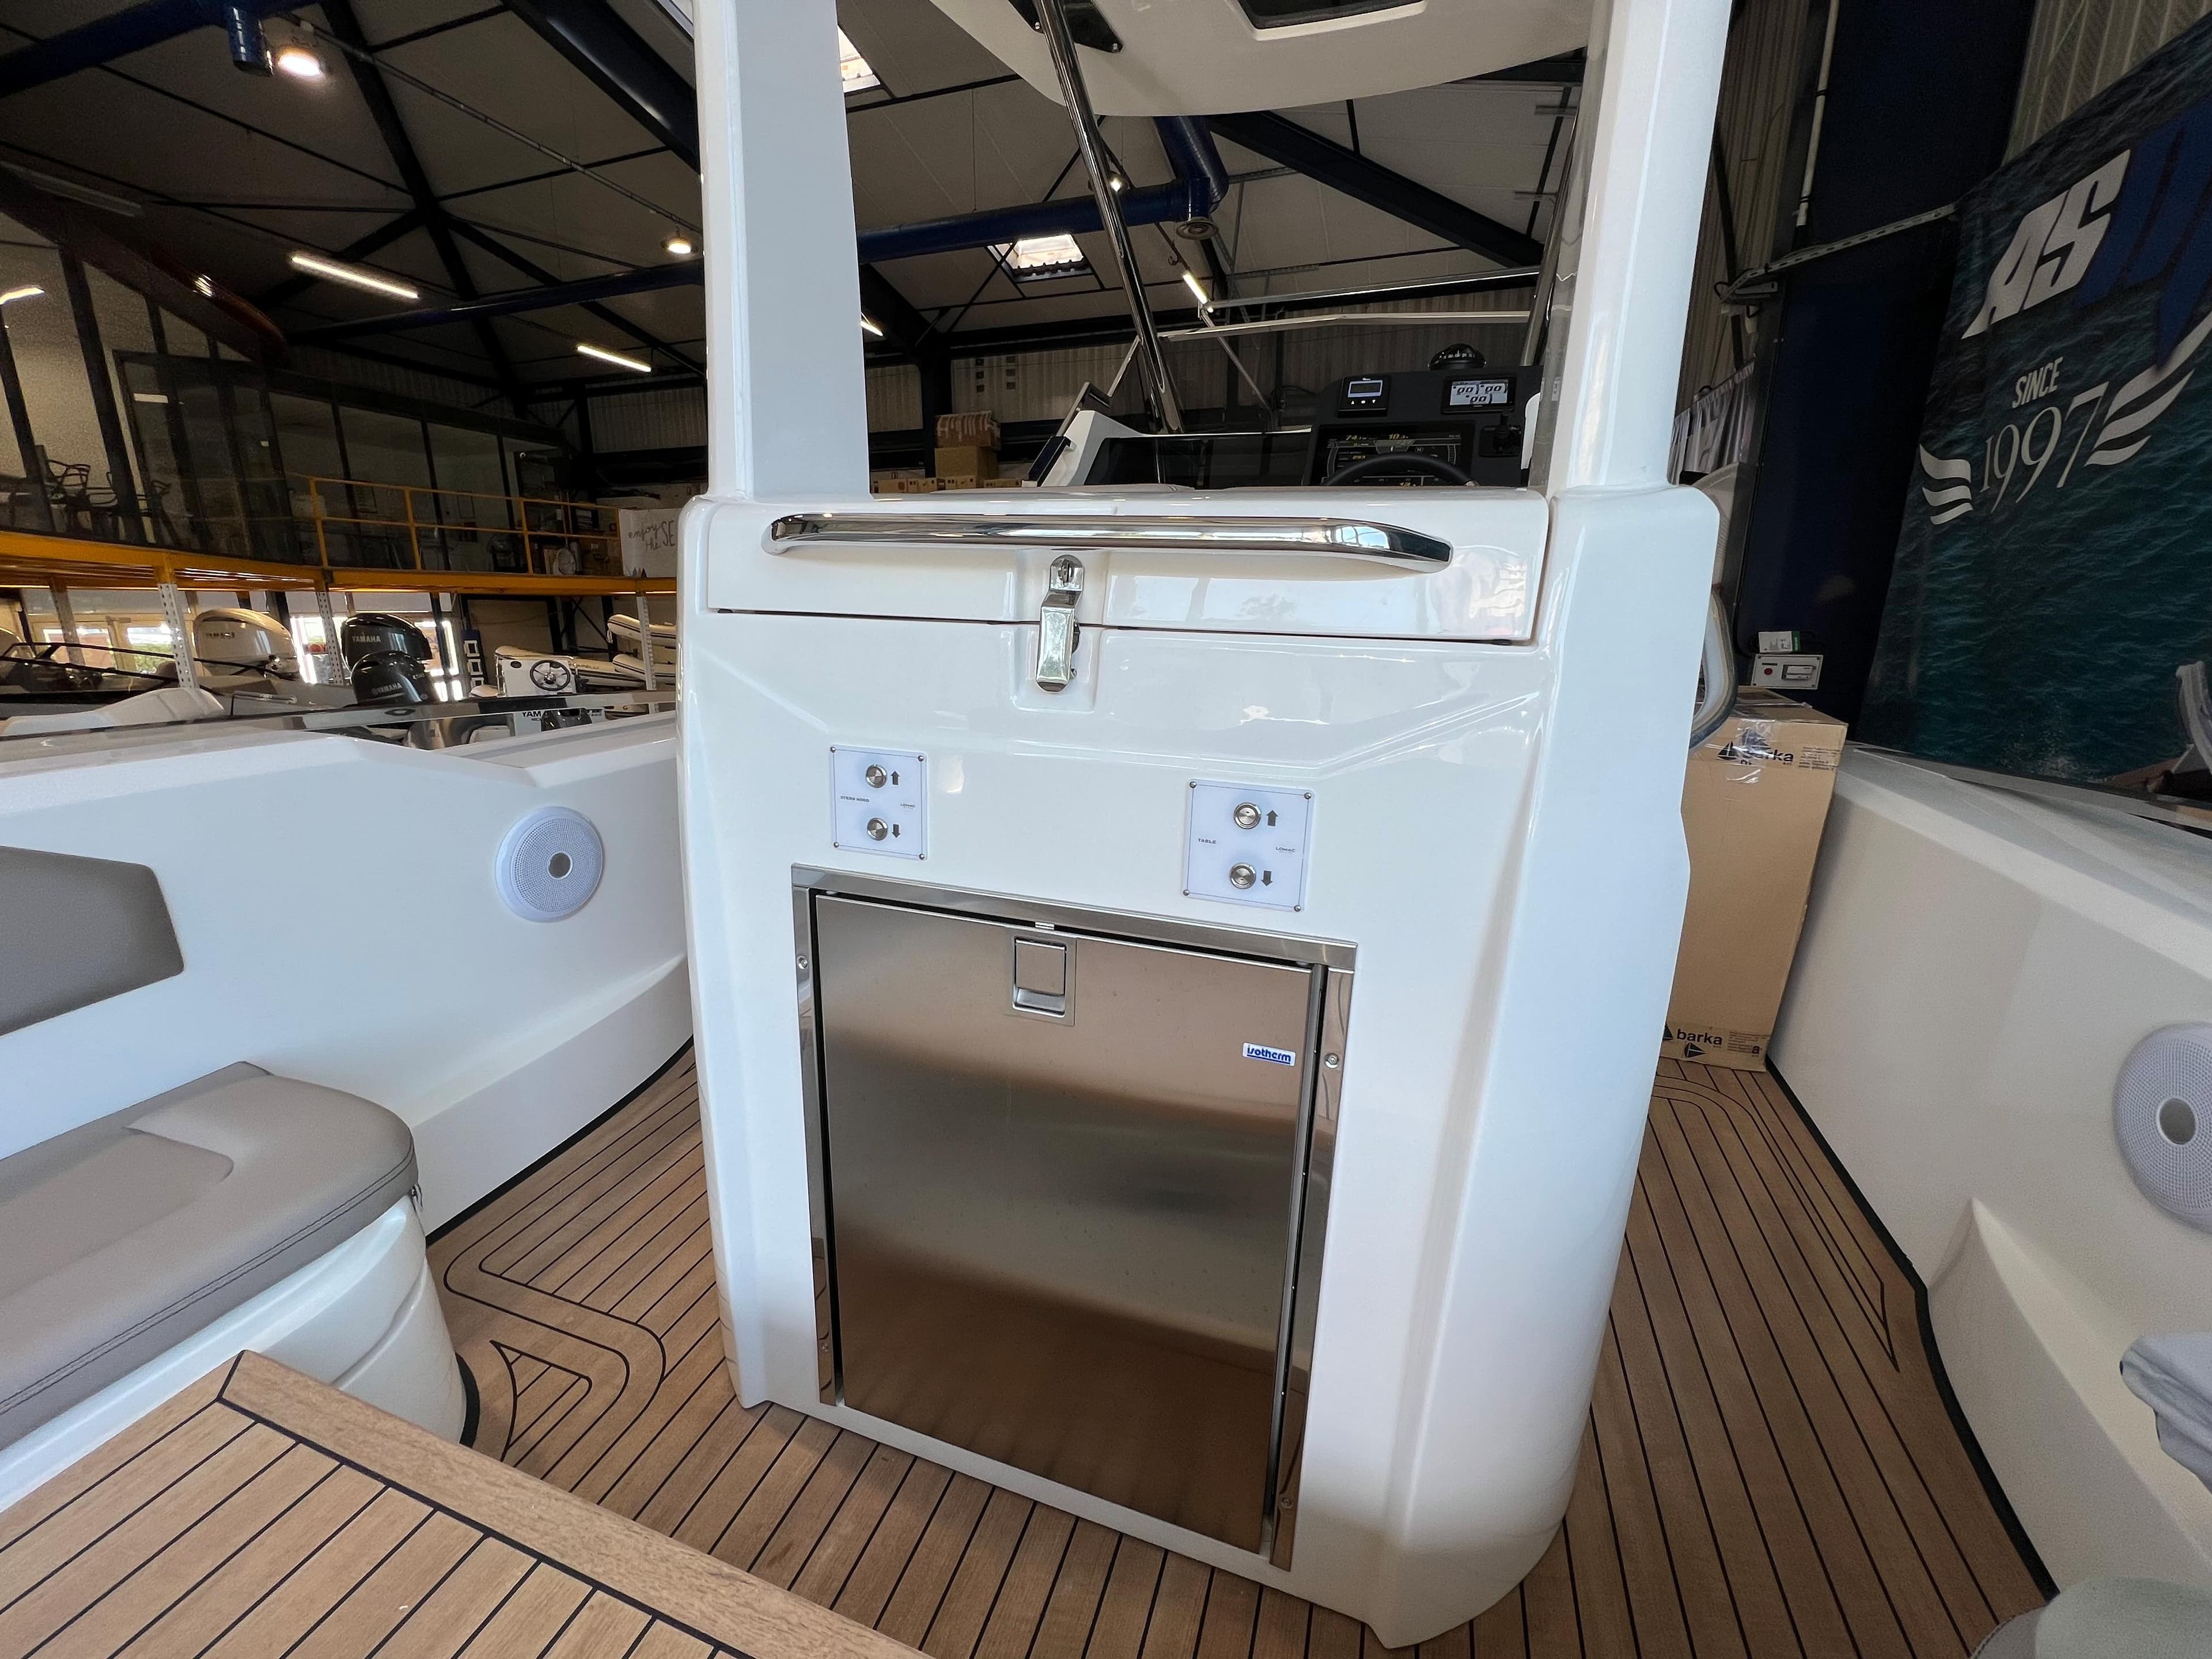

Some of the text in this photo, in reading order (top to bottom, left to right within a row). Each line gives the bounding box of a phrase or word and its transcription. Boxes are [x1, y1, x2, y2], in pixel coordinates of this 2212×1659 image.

[2011, 356, 2064, 409] SINCE
[1979, 381, 2109, 514] 1997
[351, 635, 381, 643] YAMAHA
[377, 682, 403, 694] YAMAHA
[1677, 1028, 1723, 1046] barka
[1247, 1044, 1291, 1062] isotherm
